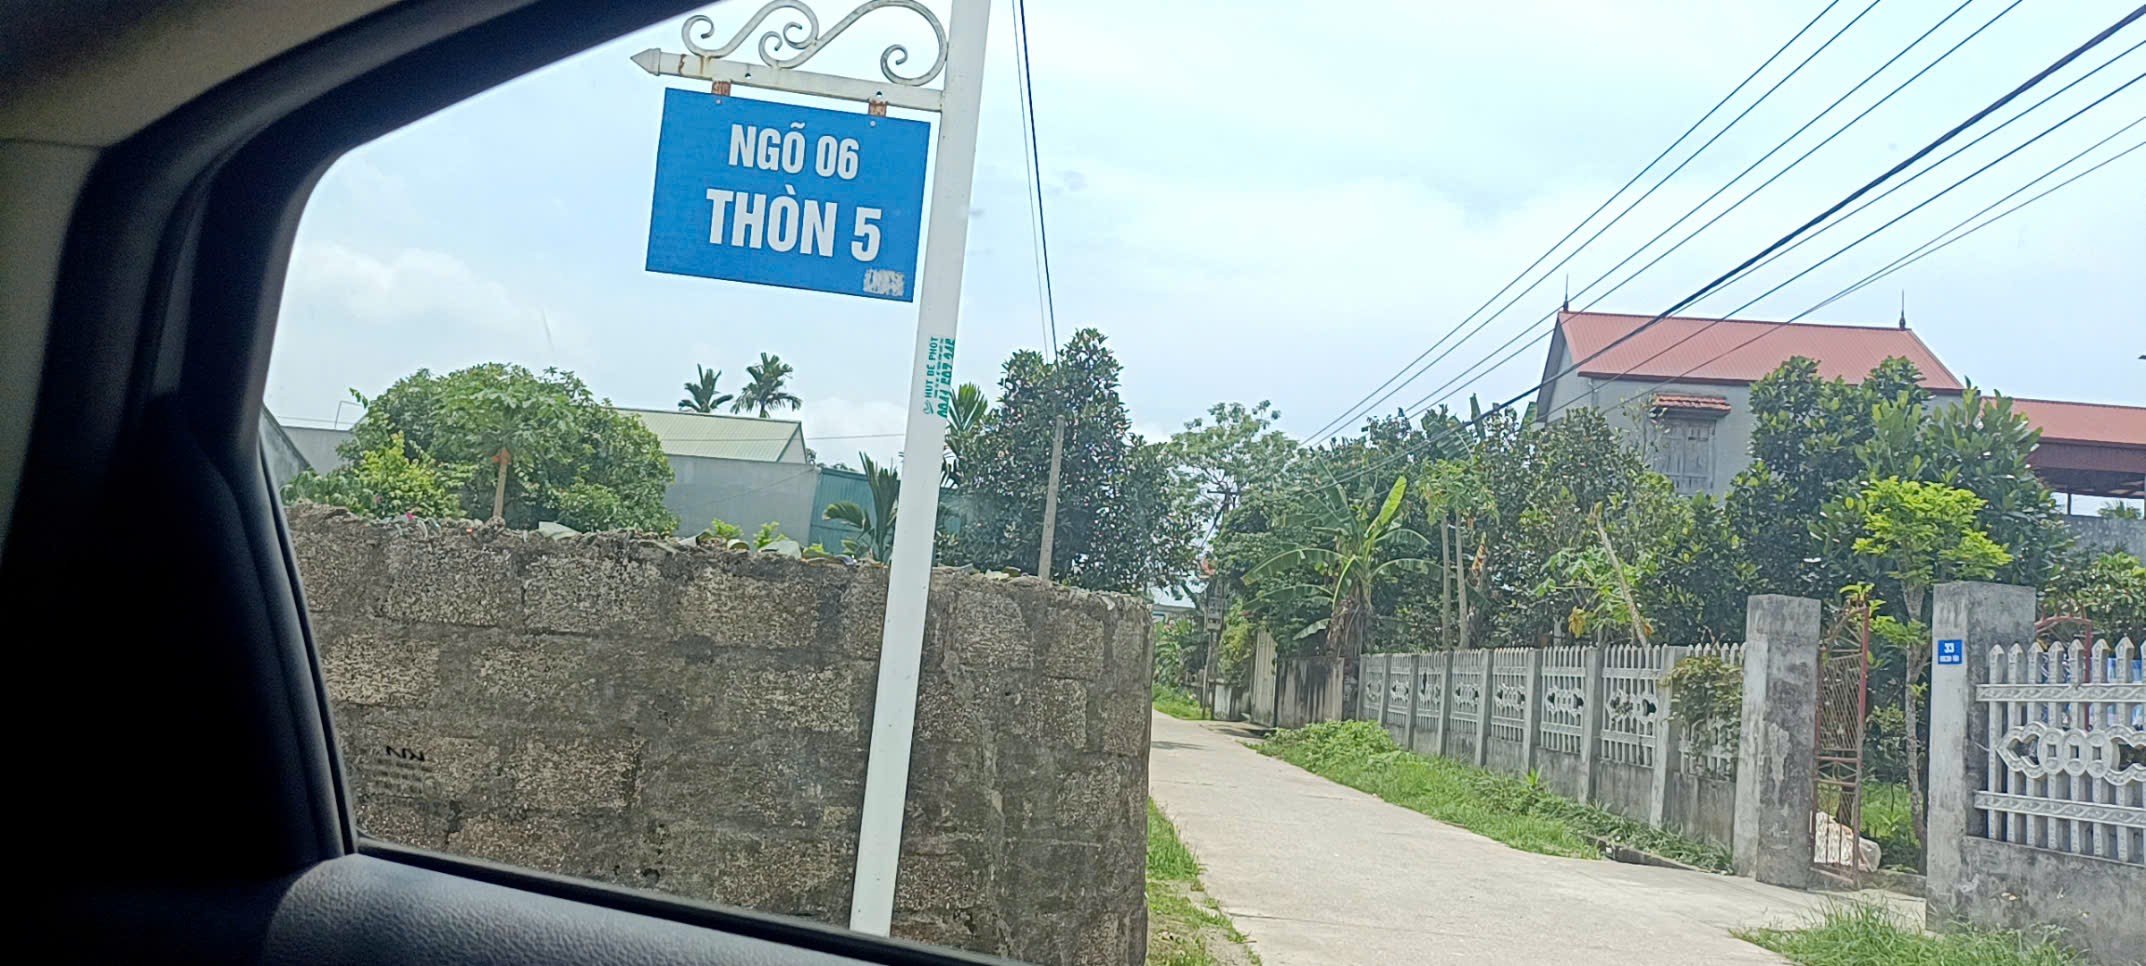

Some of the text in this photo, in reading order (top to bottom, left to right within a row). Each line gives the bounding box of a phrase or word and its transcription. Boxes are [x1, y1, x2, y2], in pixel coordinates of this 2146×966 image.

[728, 122, 860, 180] NGÕ 06
[706, 184, 882, 262] THÒN 5
